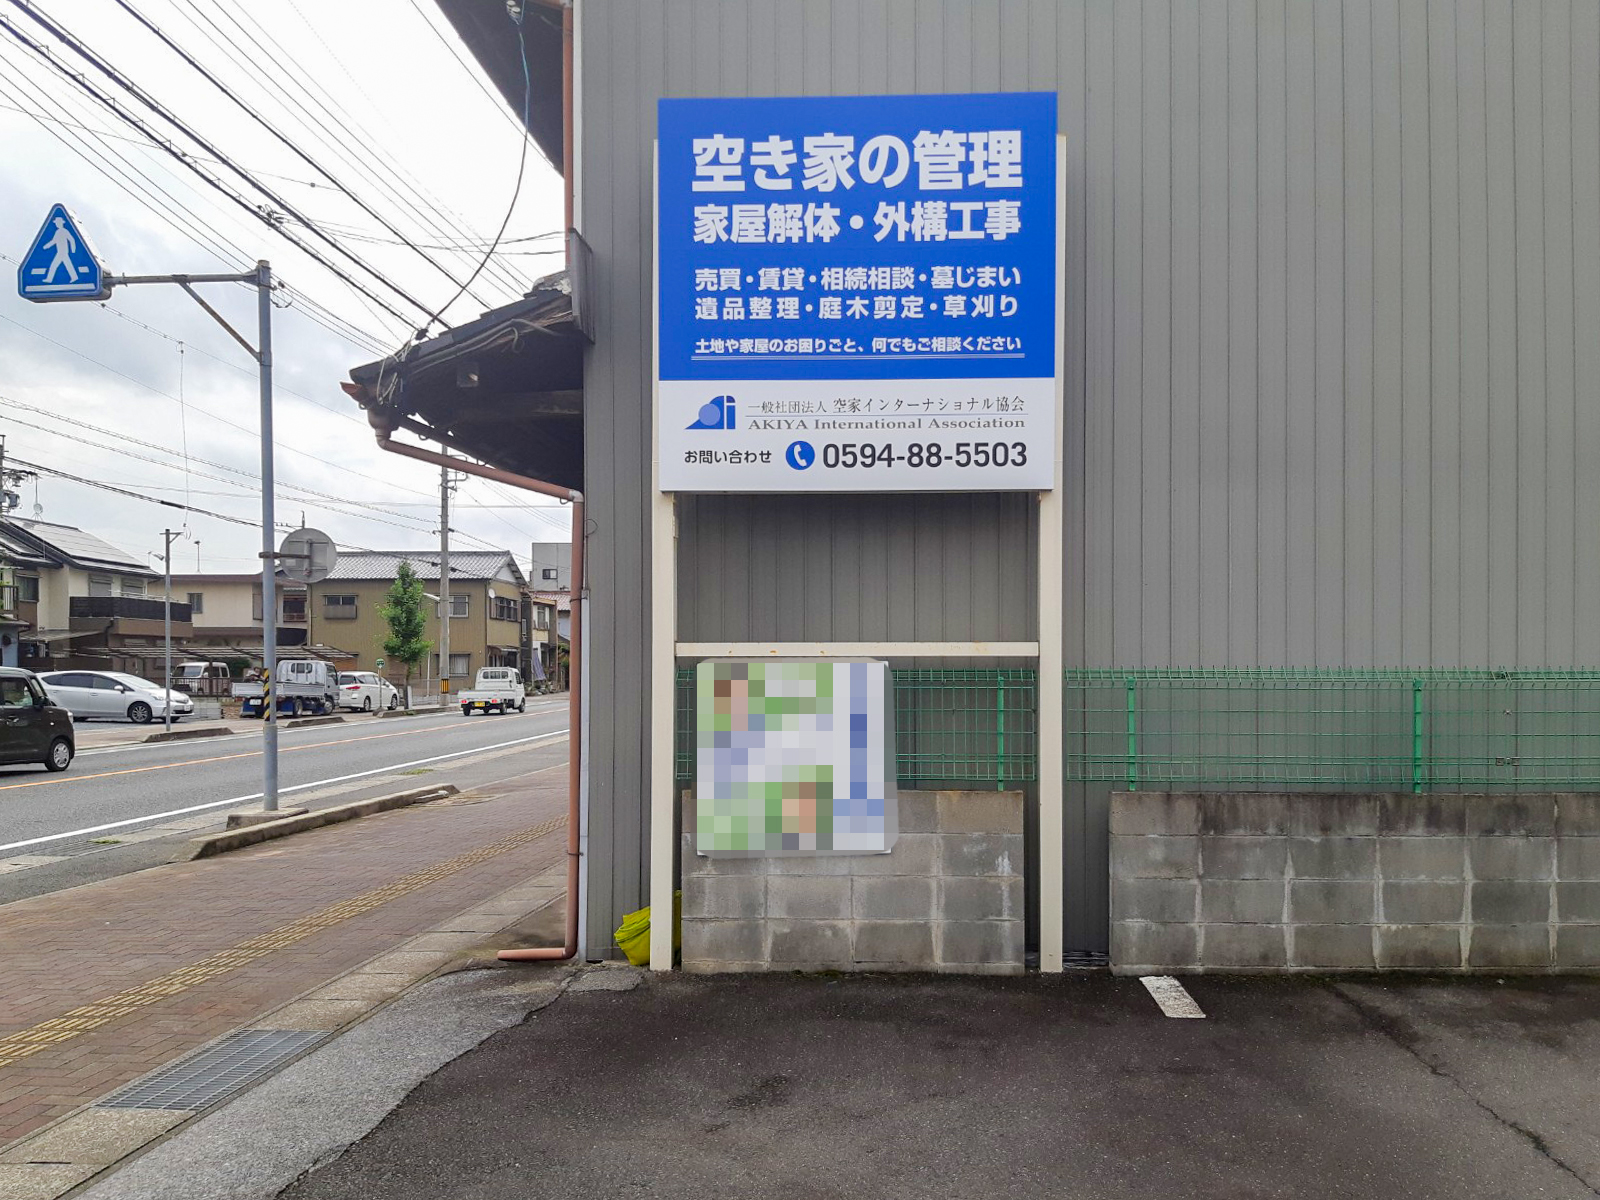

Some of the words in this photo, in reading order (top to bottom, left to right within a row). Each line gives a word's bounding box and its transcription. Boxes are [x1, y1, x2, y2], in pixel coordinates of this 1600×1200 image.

[691, 129, 1023, 193] 空き家の管理
[693, 200, 1022, 244] 家屋解体・外構工事
[694, 265, 1022, 292] 売買・賃貸・相続相談・墓じまい
[694, 294, 1019, 320] 遺品整理・庭木剪定・草刈り
[694, 336, 1022, 355] 土地や家屋のお困りごと、何でもご相談ください
[747, 400, 827, 414] 一般社団法人
[833, 395, 1025, 413] 空家インターナショナル協会
[748, 419, 808, 430] AKIYA
[814, 418, 922, 430] International
[928, 417, 1026, 429] Association
[684, 449, 772, 464] お問い合わせ
[822, 441, 1027, 469] 0594-88-5503
